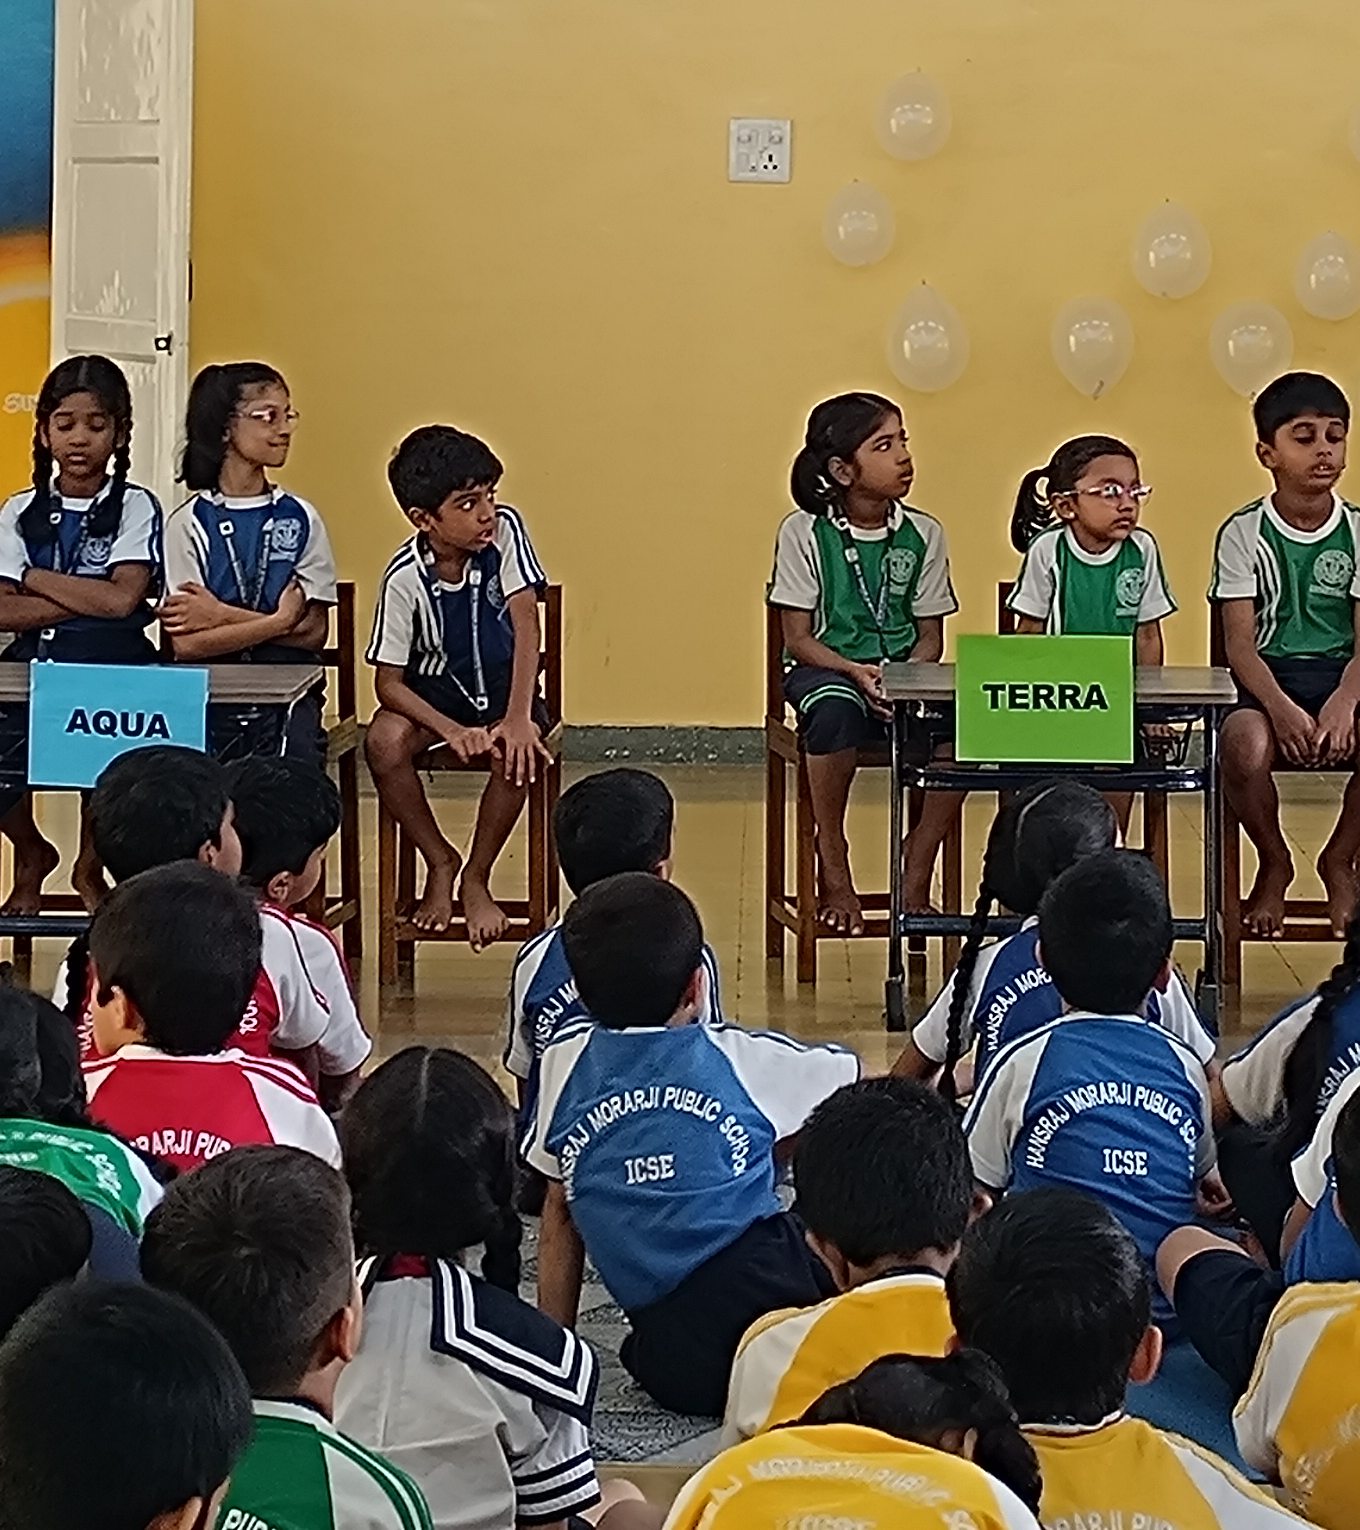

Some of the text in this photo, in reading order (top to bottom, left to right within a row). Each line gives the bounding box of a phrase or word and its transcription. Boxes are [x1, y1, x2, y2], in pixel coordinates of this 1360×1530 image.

[982, 683, 1109, 710] TERRA
[65, 708, 171, 739] AQUA
[587, 1086, 660, 1133] MORARJI
[663, 1086, 721, 1122] PUBLIC
[1026, 1082, 1182, 1169] HANSRAJ MORARJI PUBLIC
[624, 1153, 676, 1185] ICSE
[1103, 1148, 1148, 1176] ICSE
